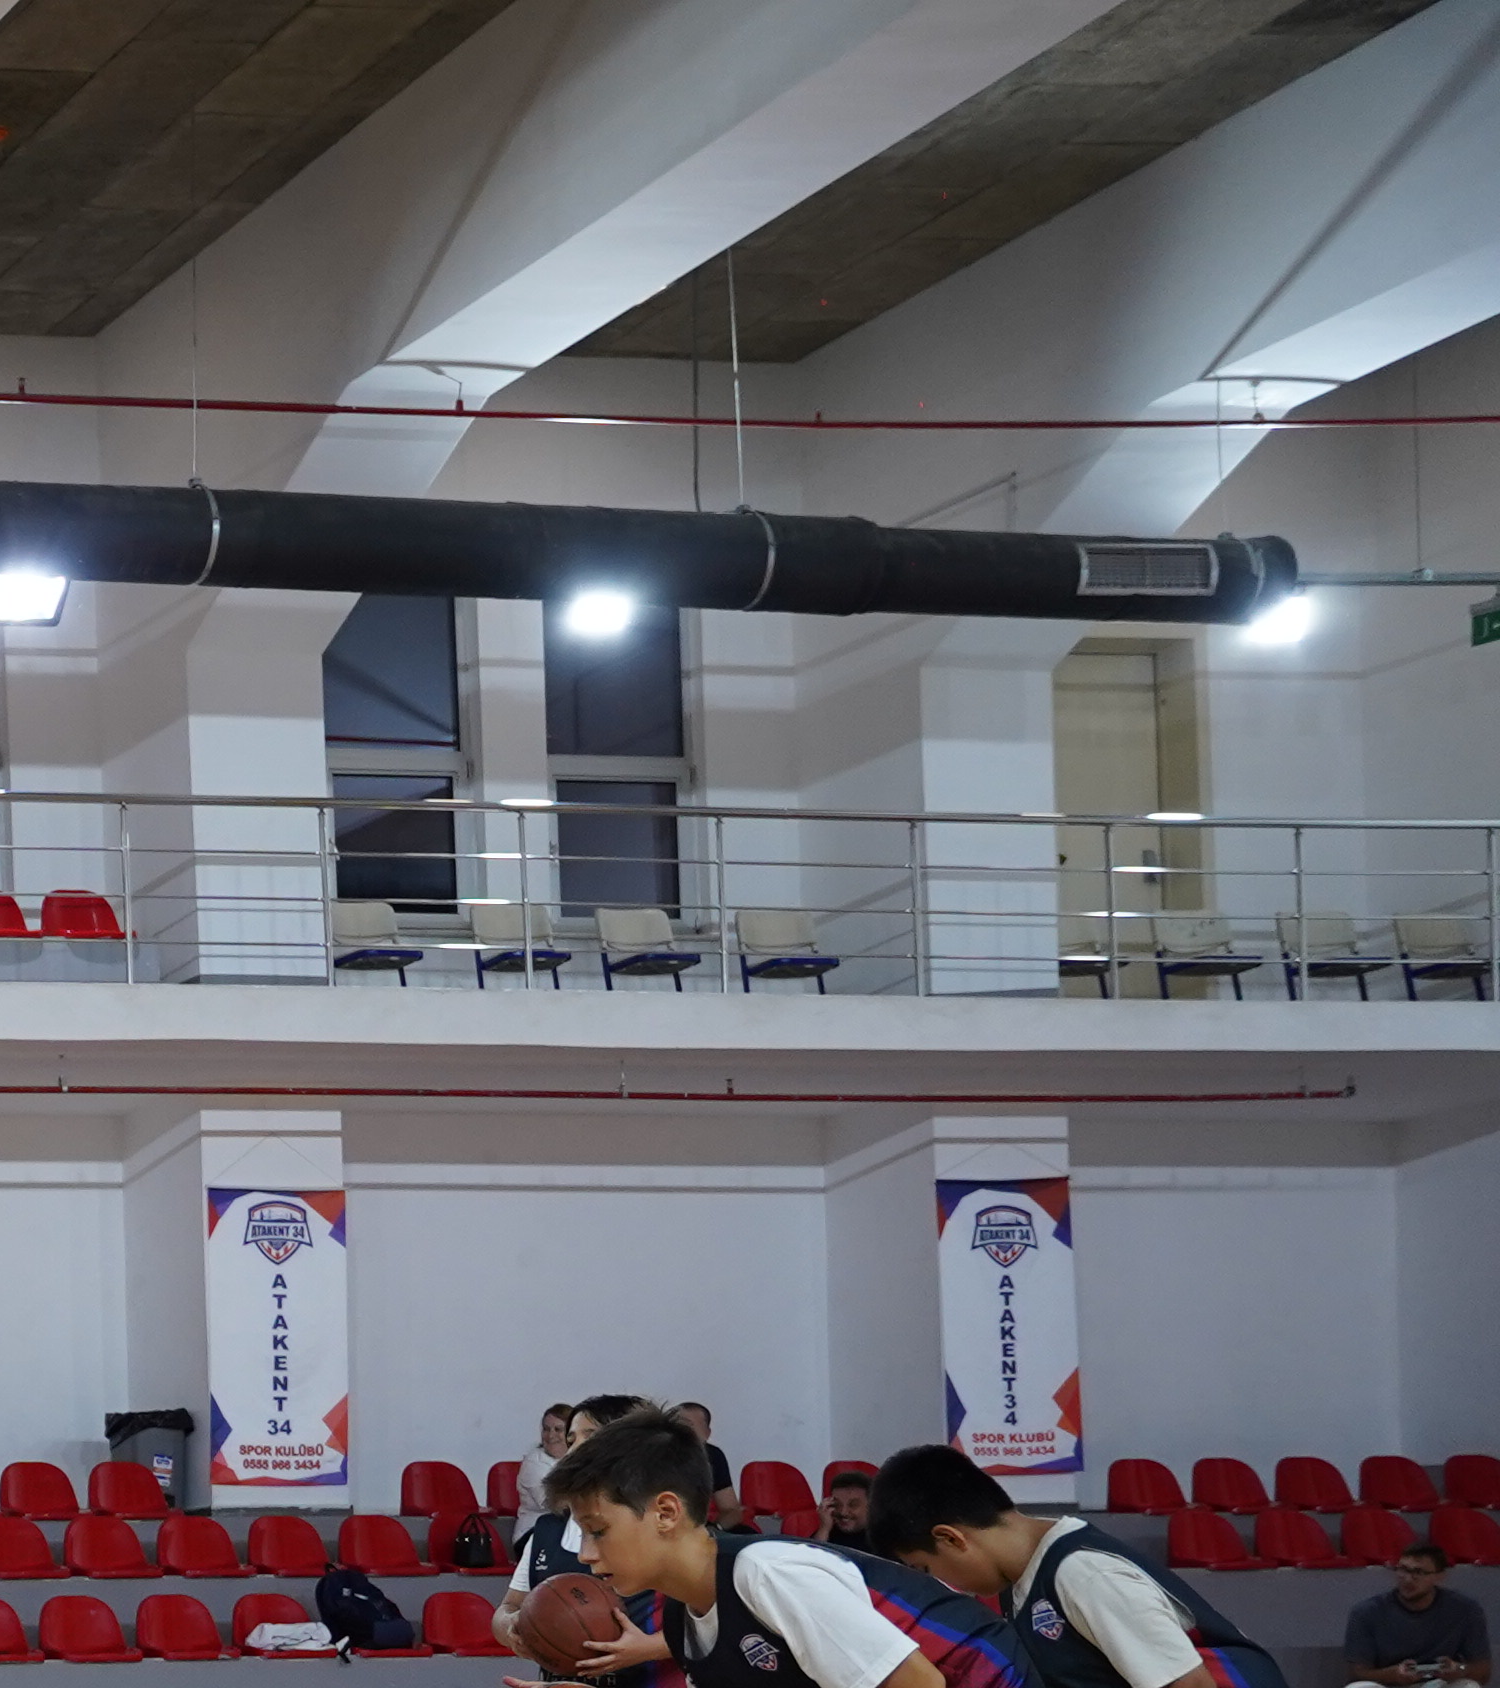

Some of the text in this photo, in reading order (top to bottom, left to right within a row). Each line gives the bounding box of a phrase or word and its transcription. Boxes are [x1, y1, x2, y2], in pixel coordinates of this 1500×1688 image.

[272, 1273, 289, 1412] ATAKENT
[267, 1420, 292, 1436] 34
[971, 1432, 1005, 1444] SPOR
[239, 1443, 324, 1457] SPOR KULÜBÜ
[294, 1459, 321, 1470] 3434
